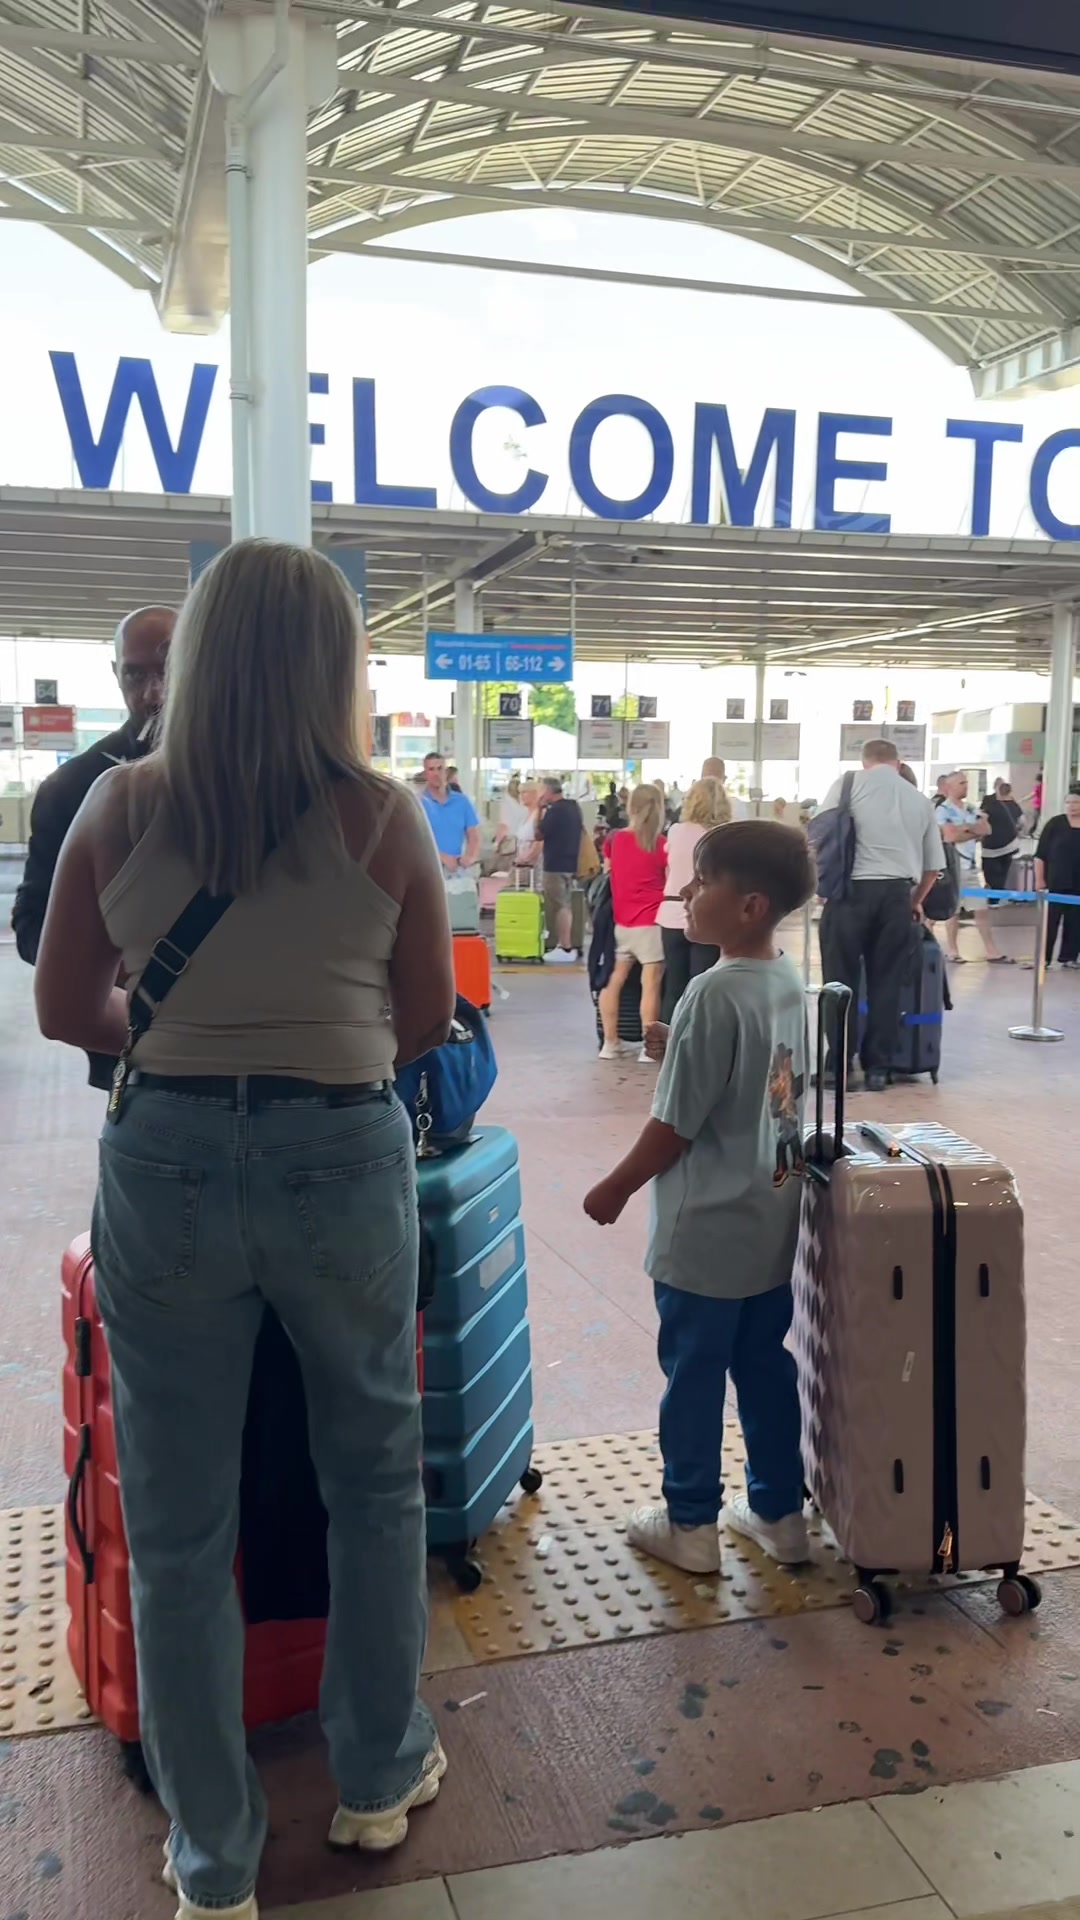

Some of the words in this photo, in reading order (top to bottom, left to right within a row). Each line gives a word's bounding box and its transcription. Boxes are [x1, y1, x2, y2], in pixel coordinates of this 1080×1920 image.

[48, 350, 892, 533] WLCOME
[501, 696, 519, 711] 70
[593, 699, 610, 713] 71
